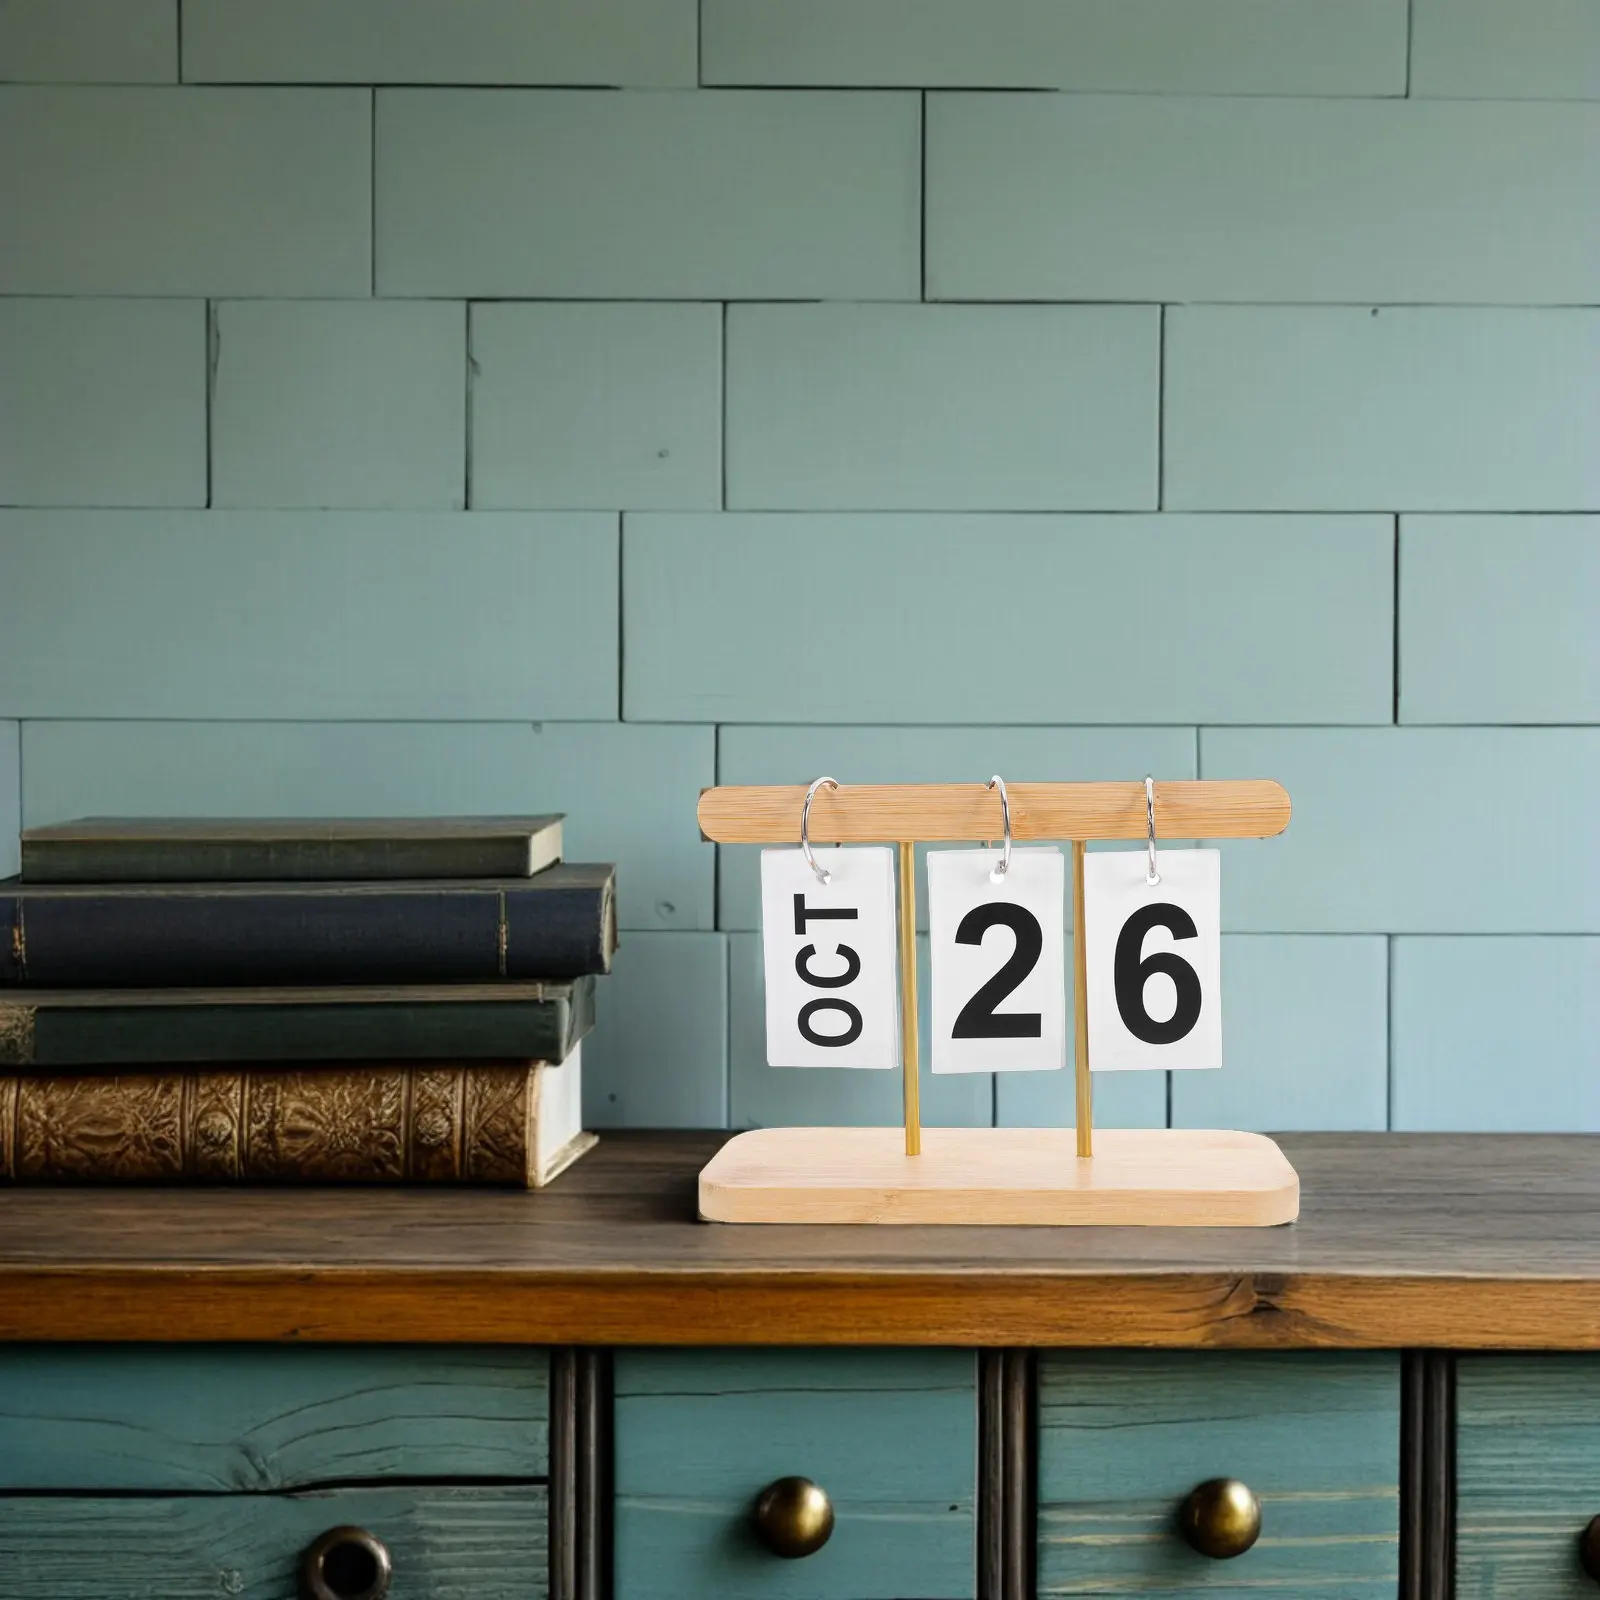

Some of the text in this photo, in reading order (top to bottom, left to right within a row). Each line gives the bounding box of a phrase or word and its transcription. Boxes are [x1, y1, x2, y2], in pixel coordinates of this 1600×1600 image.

[793, 893, 863, 1048] OCT
[951, 902, 1043, 1039] 2
[1113, 902, 1202, 1045] 6
